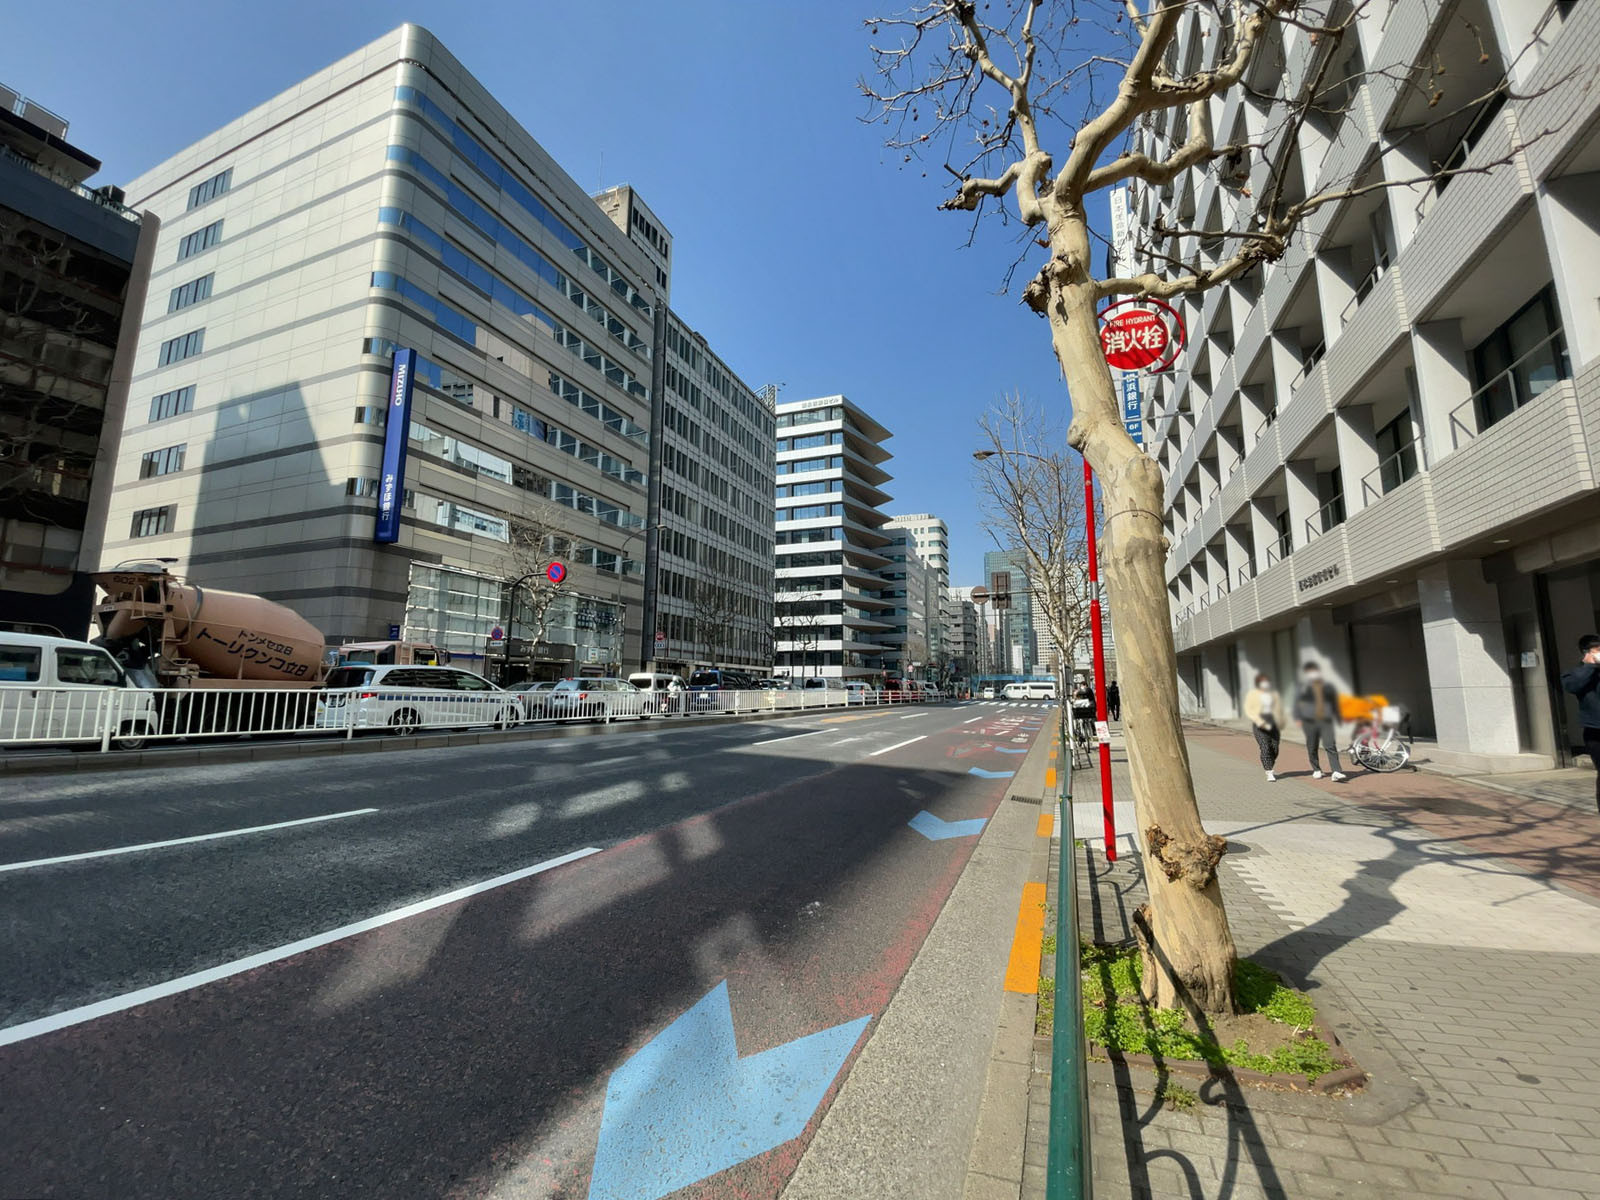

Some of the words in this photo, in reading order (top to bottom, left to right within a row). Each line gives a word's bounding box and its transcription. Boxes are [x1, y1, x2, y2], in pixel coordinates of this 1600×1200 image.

[1125, 314, 1156, 326] HYDRANT
[1104, 324, 1164, 355] 消火栓
[395, 364, 406, 406] MIZUHO
[382, 474, 393, 520] みずほ銀行
